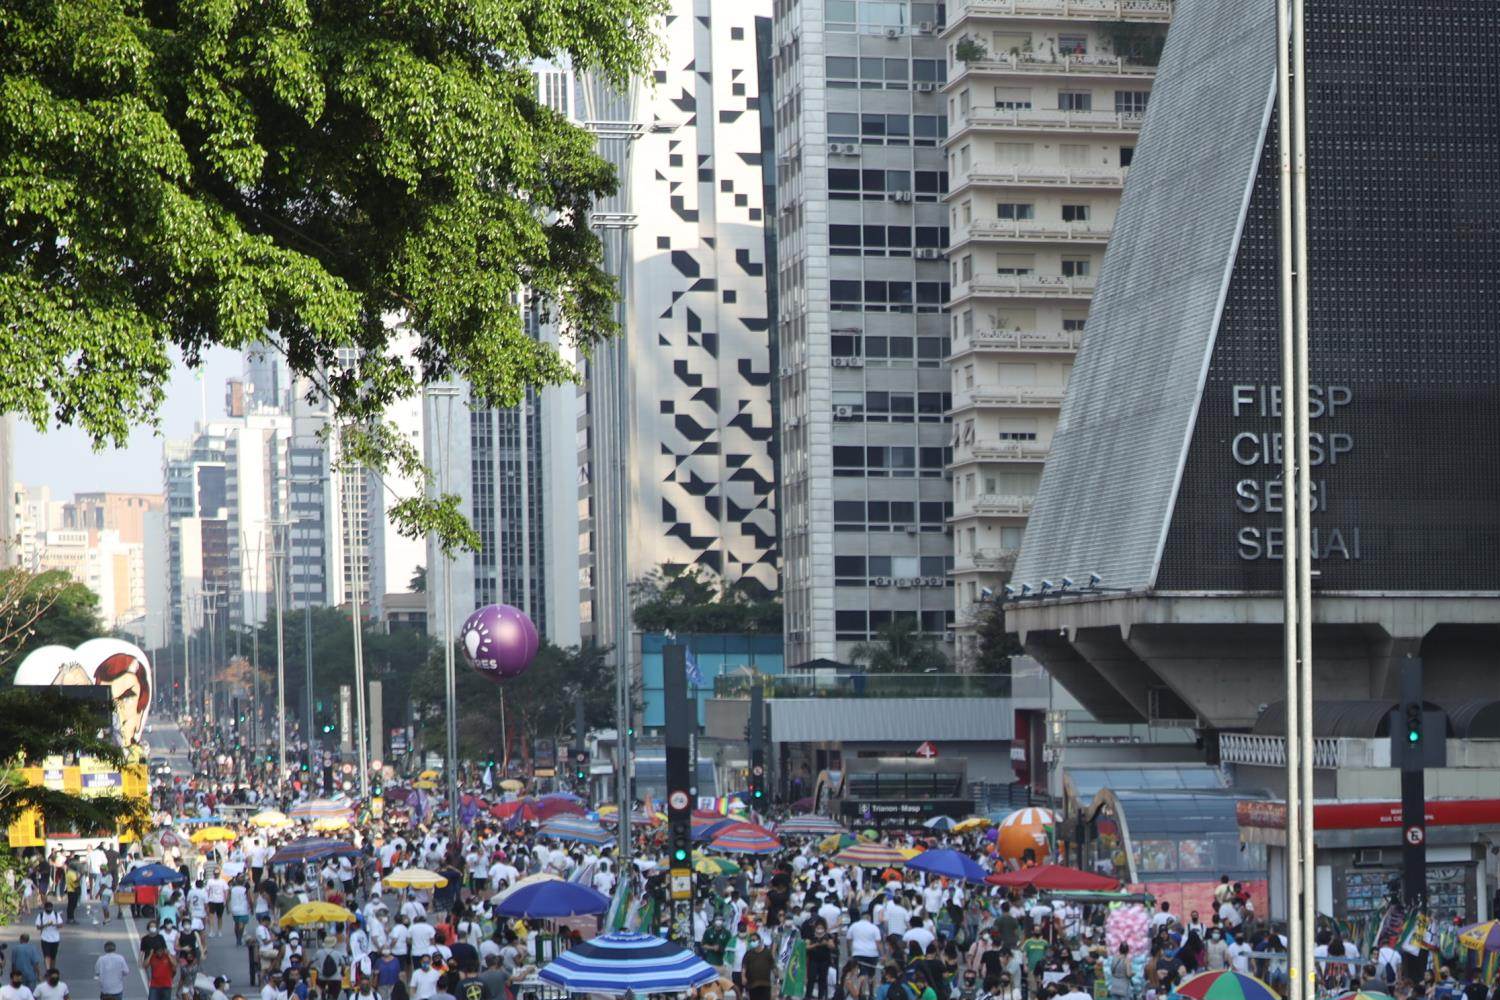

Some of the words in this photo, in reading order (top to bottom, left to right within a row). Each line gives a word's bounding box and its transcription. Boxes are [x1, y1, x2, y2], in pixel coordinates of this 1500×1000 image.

[1232, 384, 1353, 418] FIESP
[1231, 432, 1354, 466] CIESP
[1235, 479, 1327, 513] SESI
[1237, 526, 1360, 560] SENAI
